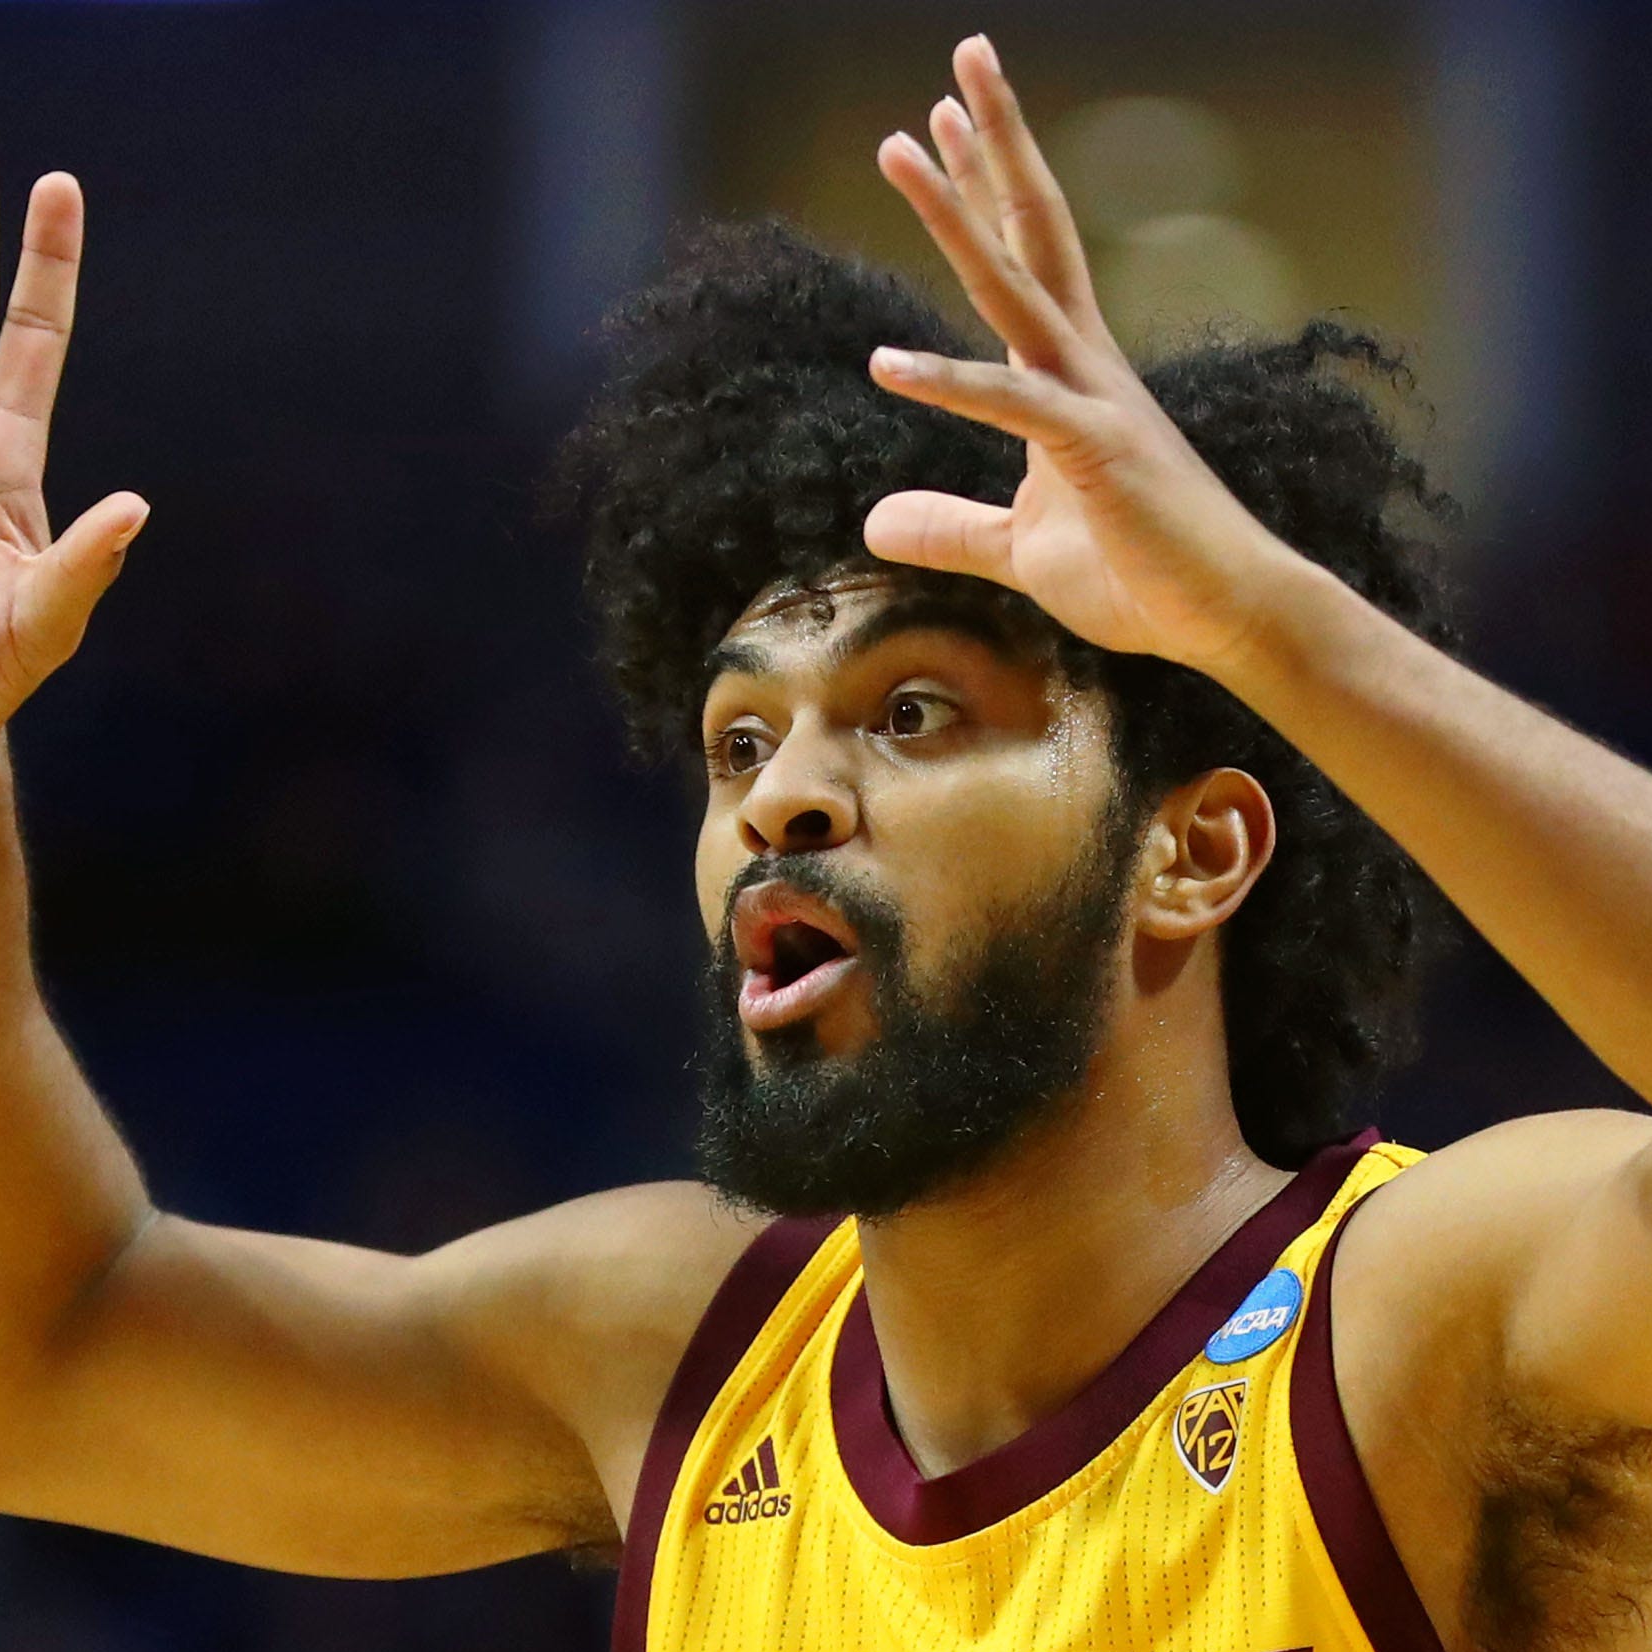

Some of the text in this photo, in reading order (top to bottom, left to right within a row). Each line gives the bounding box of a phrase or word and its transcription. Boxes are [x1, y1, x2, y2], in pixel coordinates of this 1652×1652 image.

[1208, 1306, 1291, 1345] NCAA
[1181, 1384, 1247, 1454] PAC
[1197, 1429, 1234, 1473] 12
[704, 1489, 791, 1525] adidas
